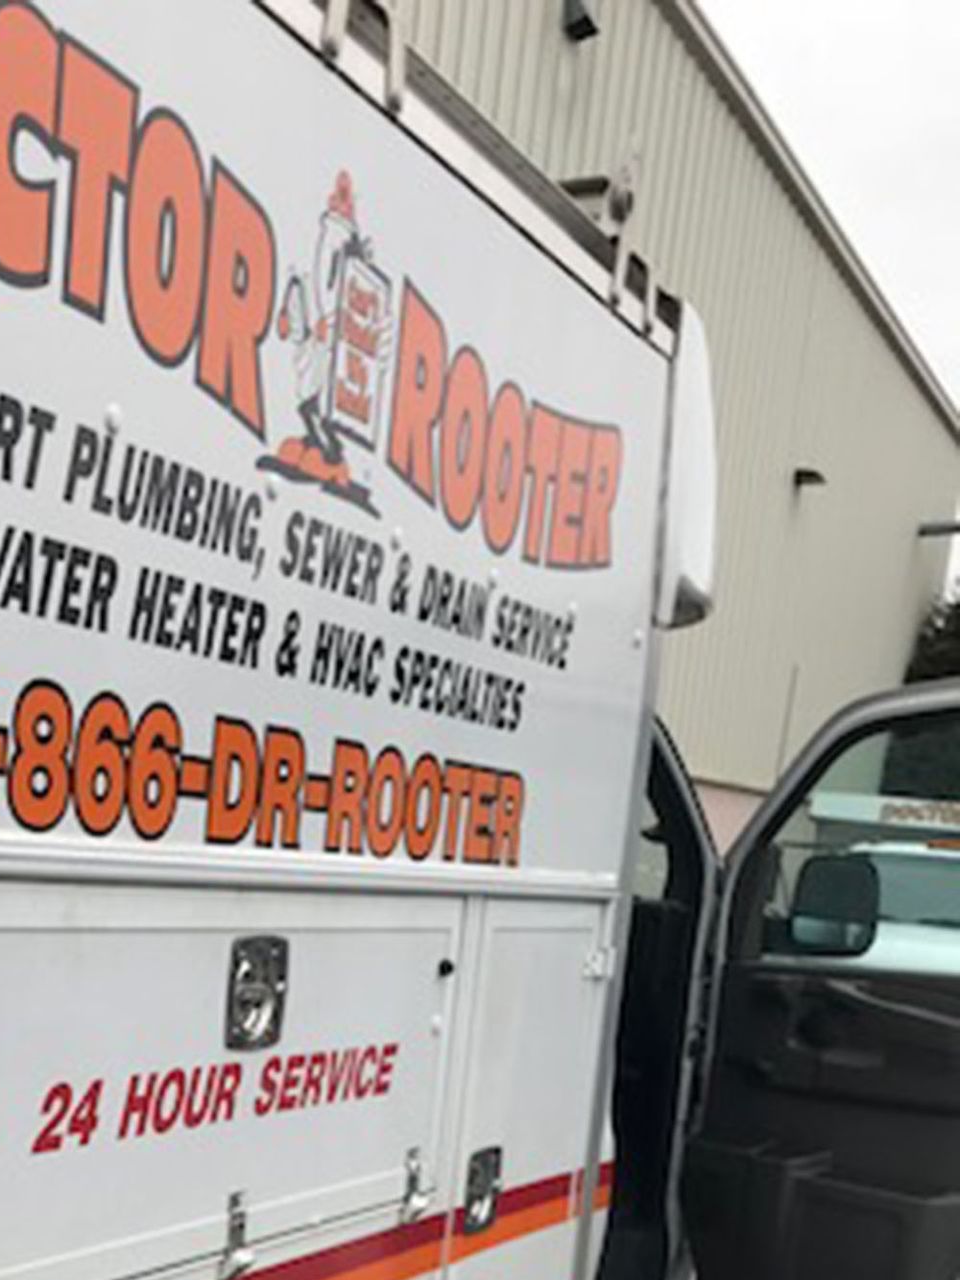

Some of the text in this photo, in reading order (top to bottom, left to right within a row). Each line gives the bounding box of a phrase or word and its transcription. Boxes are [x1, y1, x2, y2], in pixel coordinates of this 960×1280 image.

[387, 275, 624, 573] ROOTER
[62, 424, 267, 579] PLUMBING,
[279, 510, 380, 607] SEWER
[390, 550, 412, 613] &
[418, 568, 491, 643] DRAIN
[491, 594, 576, 671] SERVICE
[129, 566, 267, 670] HEATER
[275, 610, 302, 678] &
[309, 622, 385, 703] HVAC
[390, 647, 526, 732] SPECIALTIES
[31, 1043, 399, 1155] 24 HOUR SERVICE
